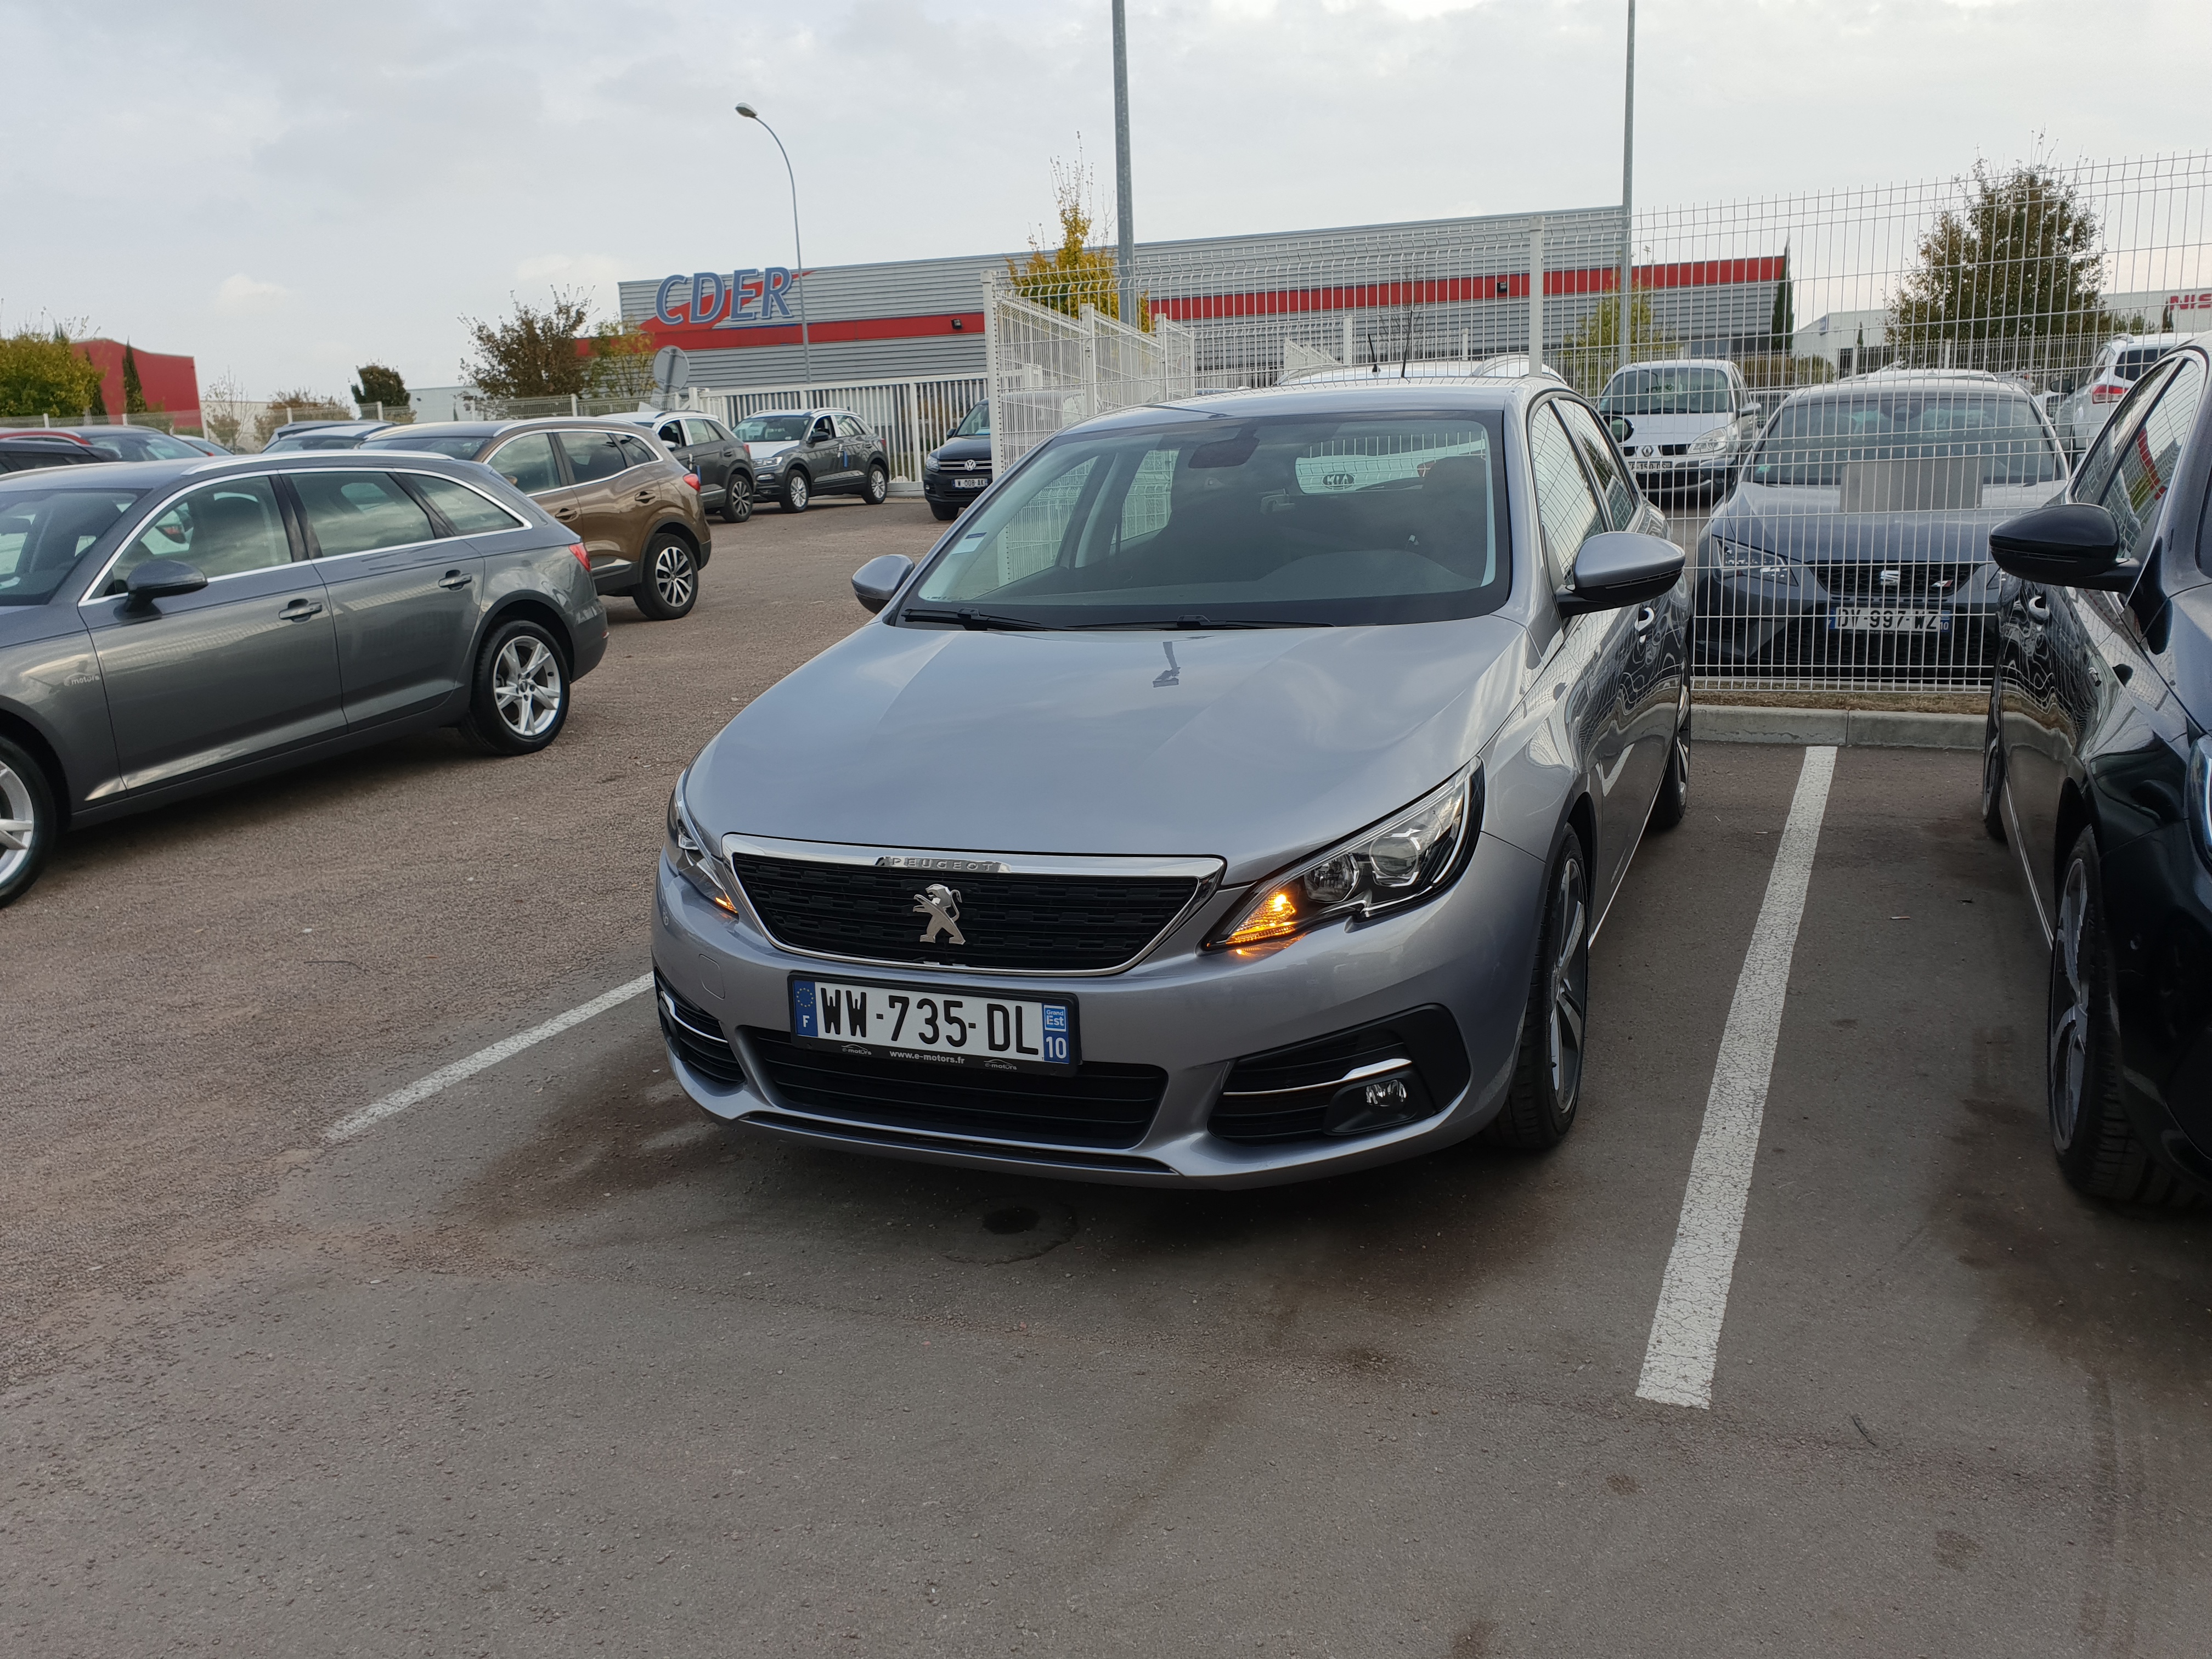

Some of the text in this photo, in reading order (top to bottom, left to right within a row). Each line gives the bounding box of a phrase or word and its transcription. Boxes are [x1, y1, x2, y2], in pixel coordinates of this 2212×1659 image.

[656, 267, 793, 325] CDER
[1327, 475, 1349, 485] KIA
[891, 857, 993, 871] PEUGEOT
[803, 1015, 810, 1028] F
[821, 988, 1039, 1056] WW-735-DL
[1047, 1015, 1064, 1026] Est
[1046, 1036, 1066, 1059] 10
[889, 1051, 965, 1064] www.e-motors.fr
